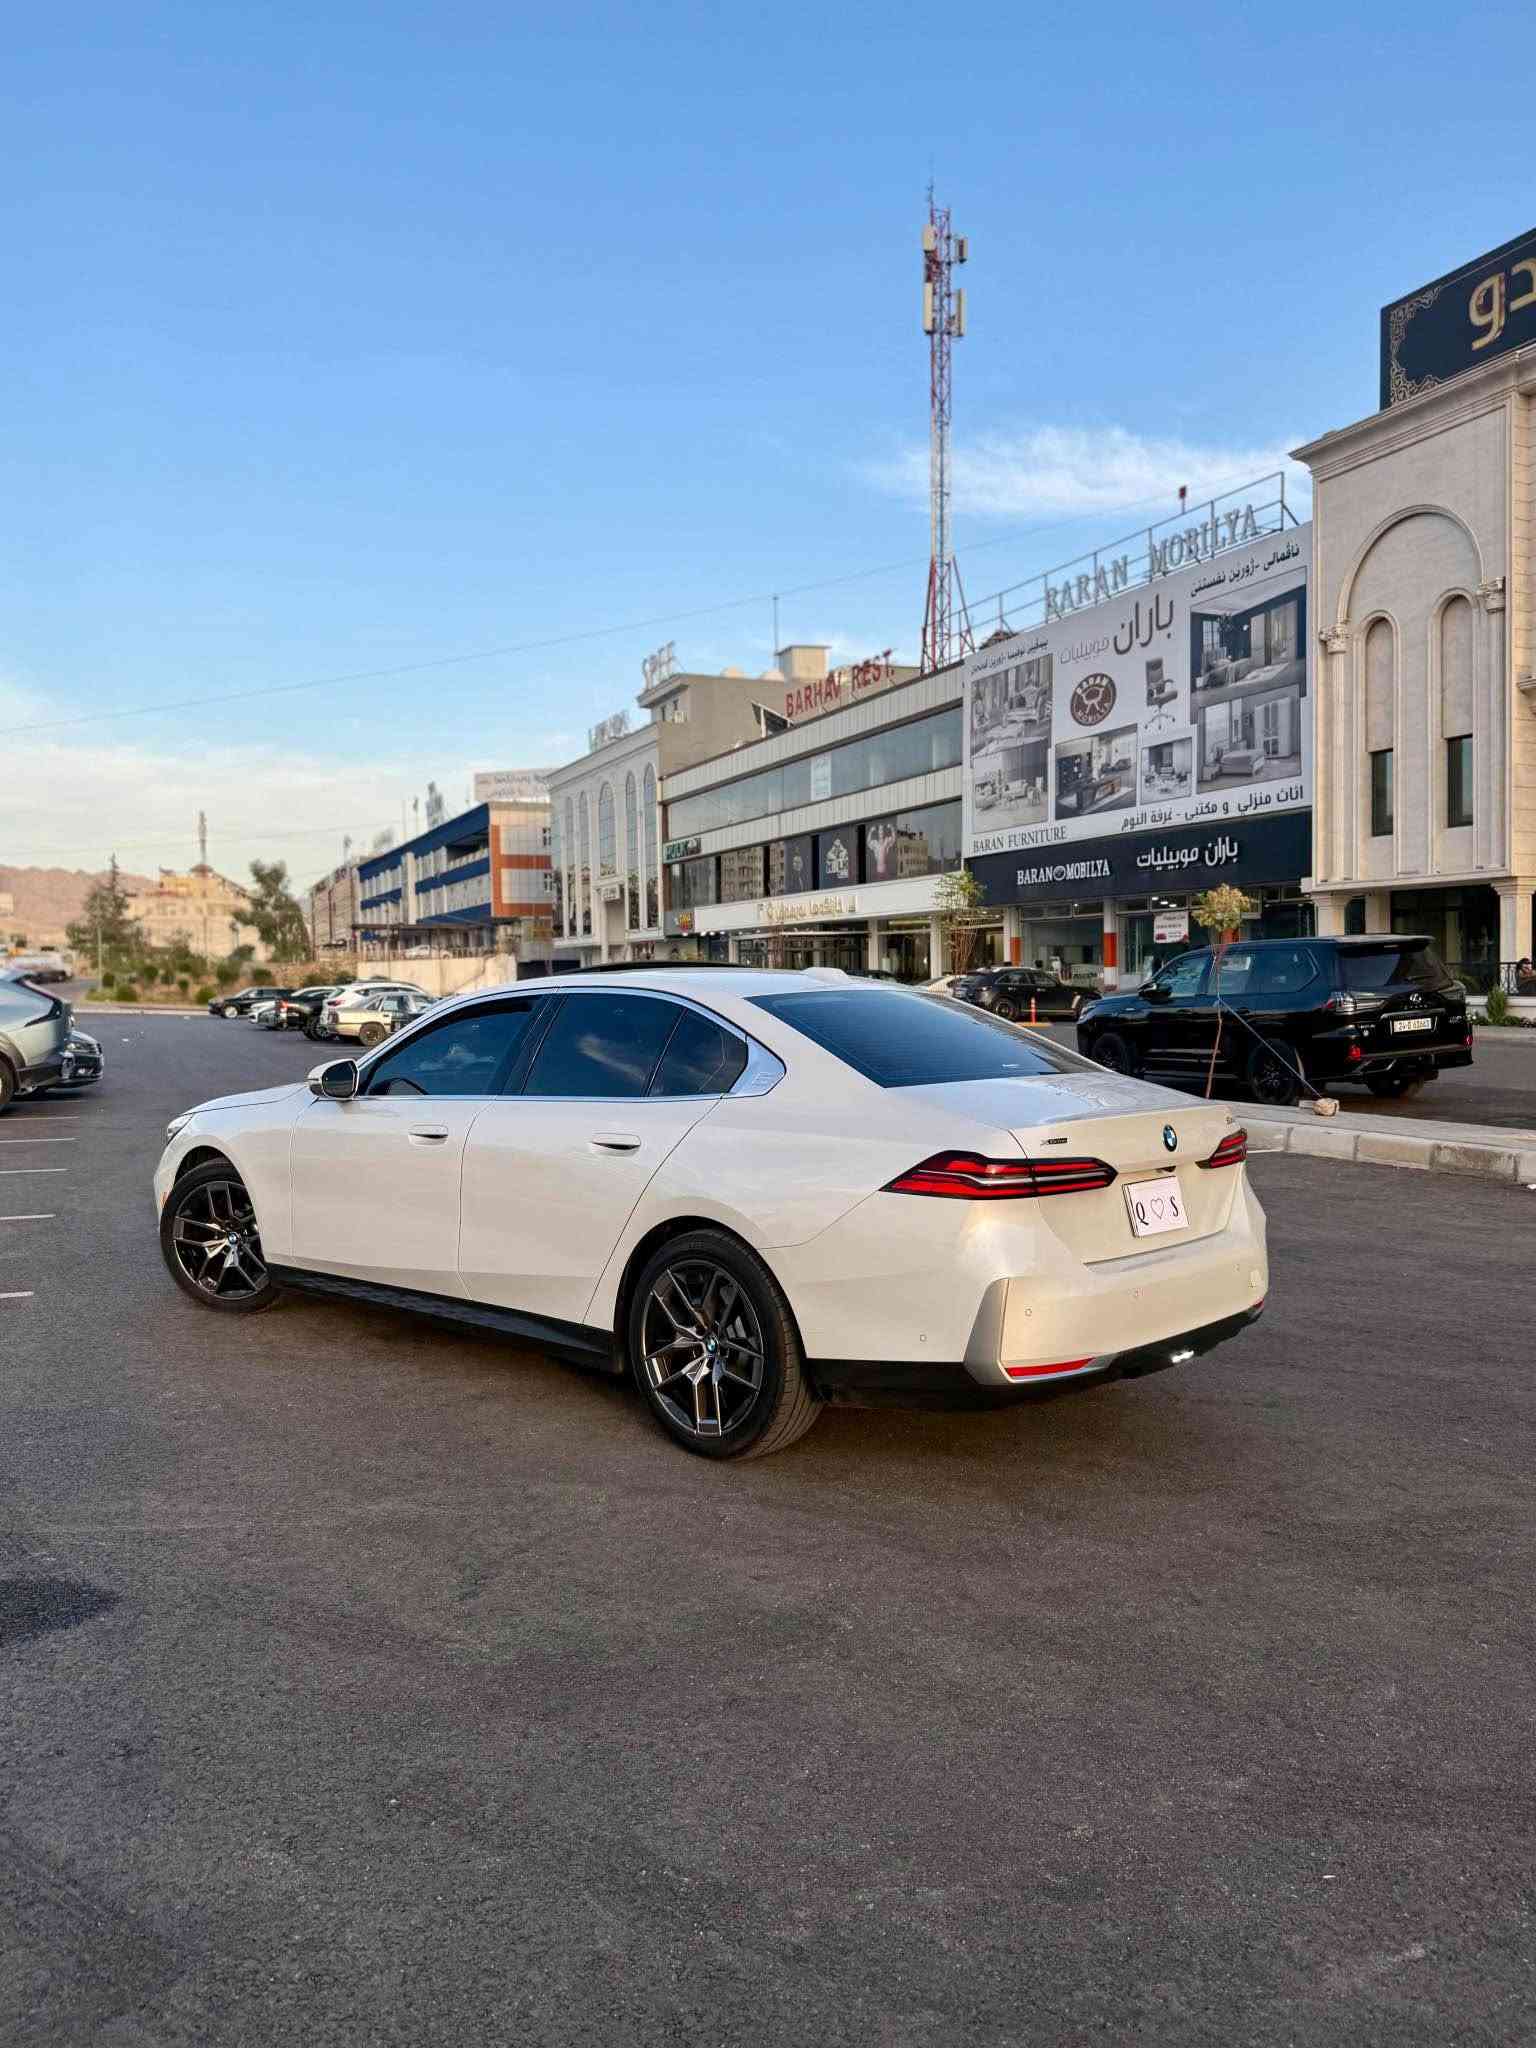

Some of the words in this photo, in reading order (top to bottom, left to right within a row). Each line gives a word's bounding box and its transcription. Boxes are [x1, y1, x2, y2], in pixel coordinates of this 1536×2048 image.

[1046, 555, 1128, 617] BARAN
[1150, 504, 1259, 573] MOBILYA
[1114, 593, 1173, 655] باران
[974, 836, 1004, 853] BARAN
[1008, 825, 1067, 848] FURNITURE
[1205, 836, 1238, 866] باران
[1017, 866, 1053, 885] BARAN
[1066, 859, 1110, 880] MOBILYA
[1136, 1202, 1149, 1225] Q
[1170, 1196, 1179, 1217] S
